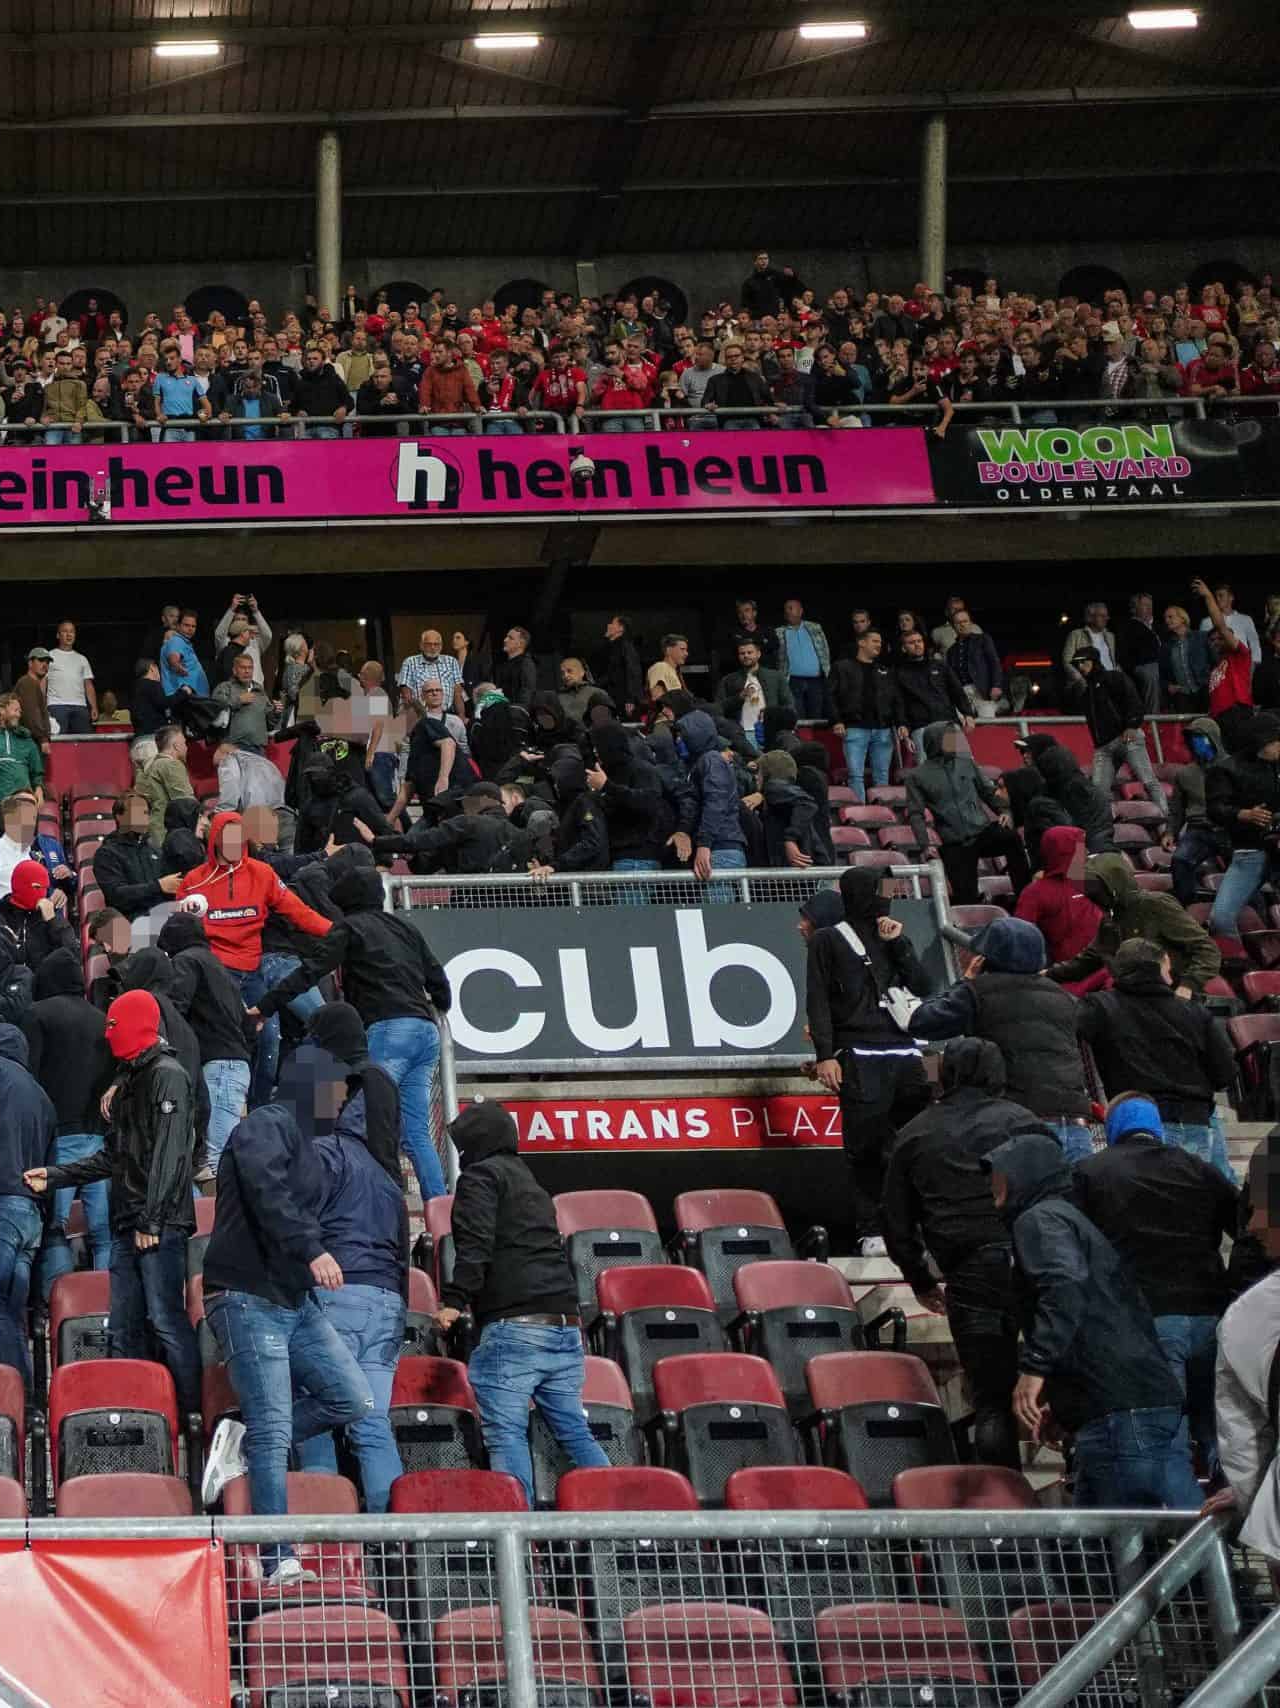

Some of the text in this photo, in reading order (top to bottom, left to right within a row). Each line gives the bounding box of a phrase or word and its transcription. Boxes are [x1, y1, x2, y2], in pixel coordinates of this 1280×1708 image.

[976, 424, 1177, 465] WOON
[109, 456, 285, 507] heun
[645, 445, 827, 496] heun
[977, 456, 1191, 483] BOULEVARD
[997, 484, 1184, 500] OLDENZAAL
[443, 909, 797, 1054] cub
[509, 1109, 710, 1140] ATRANS
